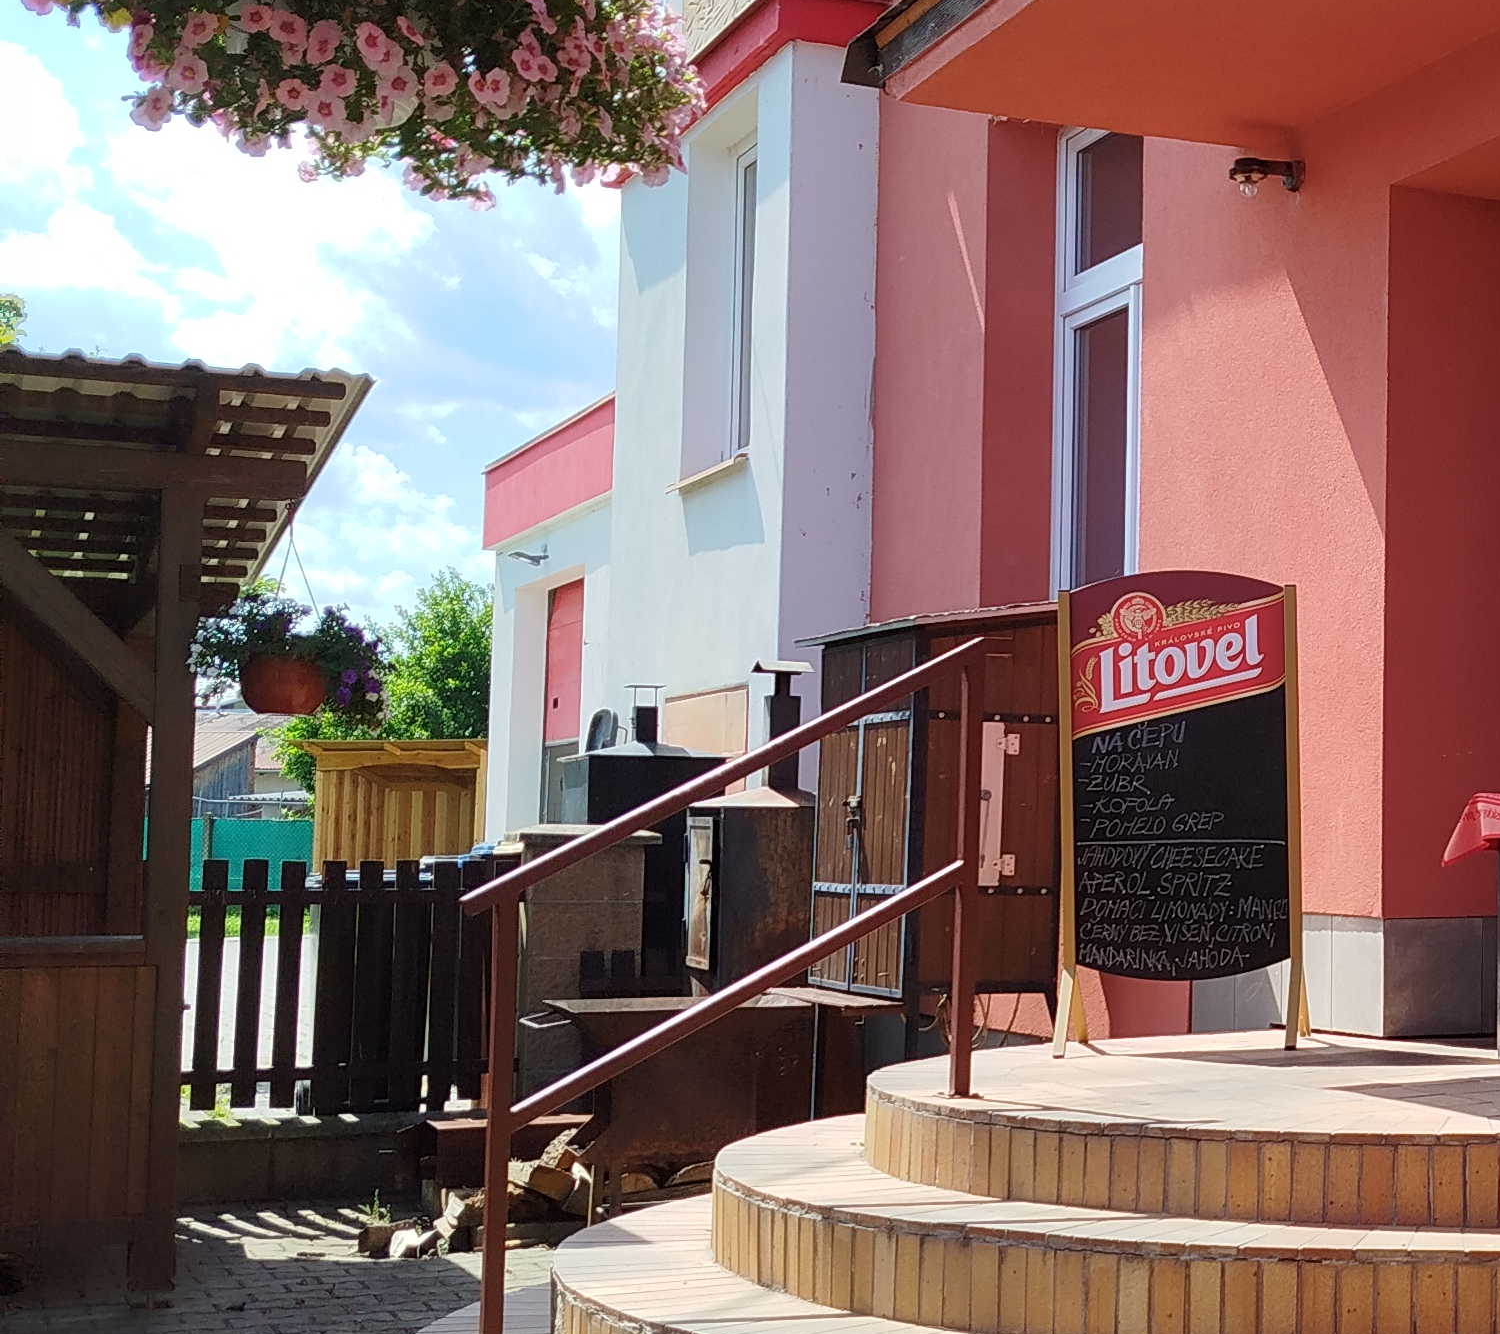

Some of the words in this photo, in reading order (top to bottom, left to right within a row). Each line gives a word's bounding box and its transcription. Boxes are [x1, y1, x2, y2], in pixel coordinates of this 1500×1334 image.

[1154, 626, 1213, 647] KRÁLOVSKÉ
[1216, 621, 1241, 633] PIVO
[1099, 614, 1264, 713] Litovel
[1091, 732, 1124, 754] NA
[1128, 720, 1186, 750] ČEPU
[1172, 811, 1225, 833] GREP
[1150, 844, 1265, 870] CHEESECAKE
[1078, 871, 1151, 895] APEROL
[1157, 871, 1232, 897] SPRITZ
